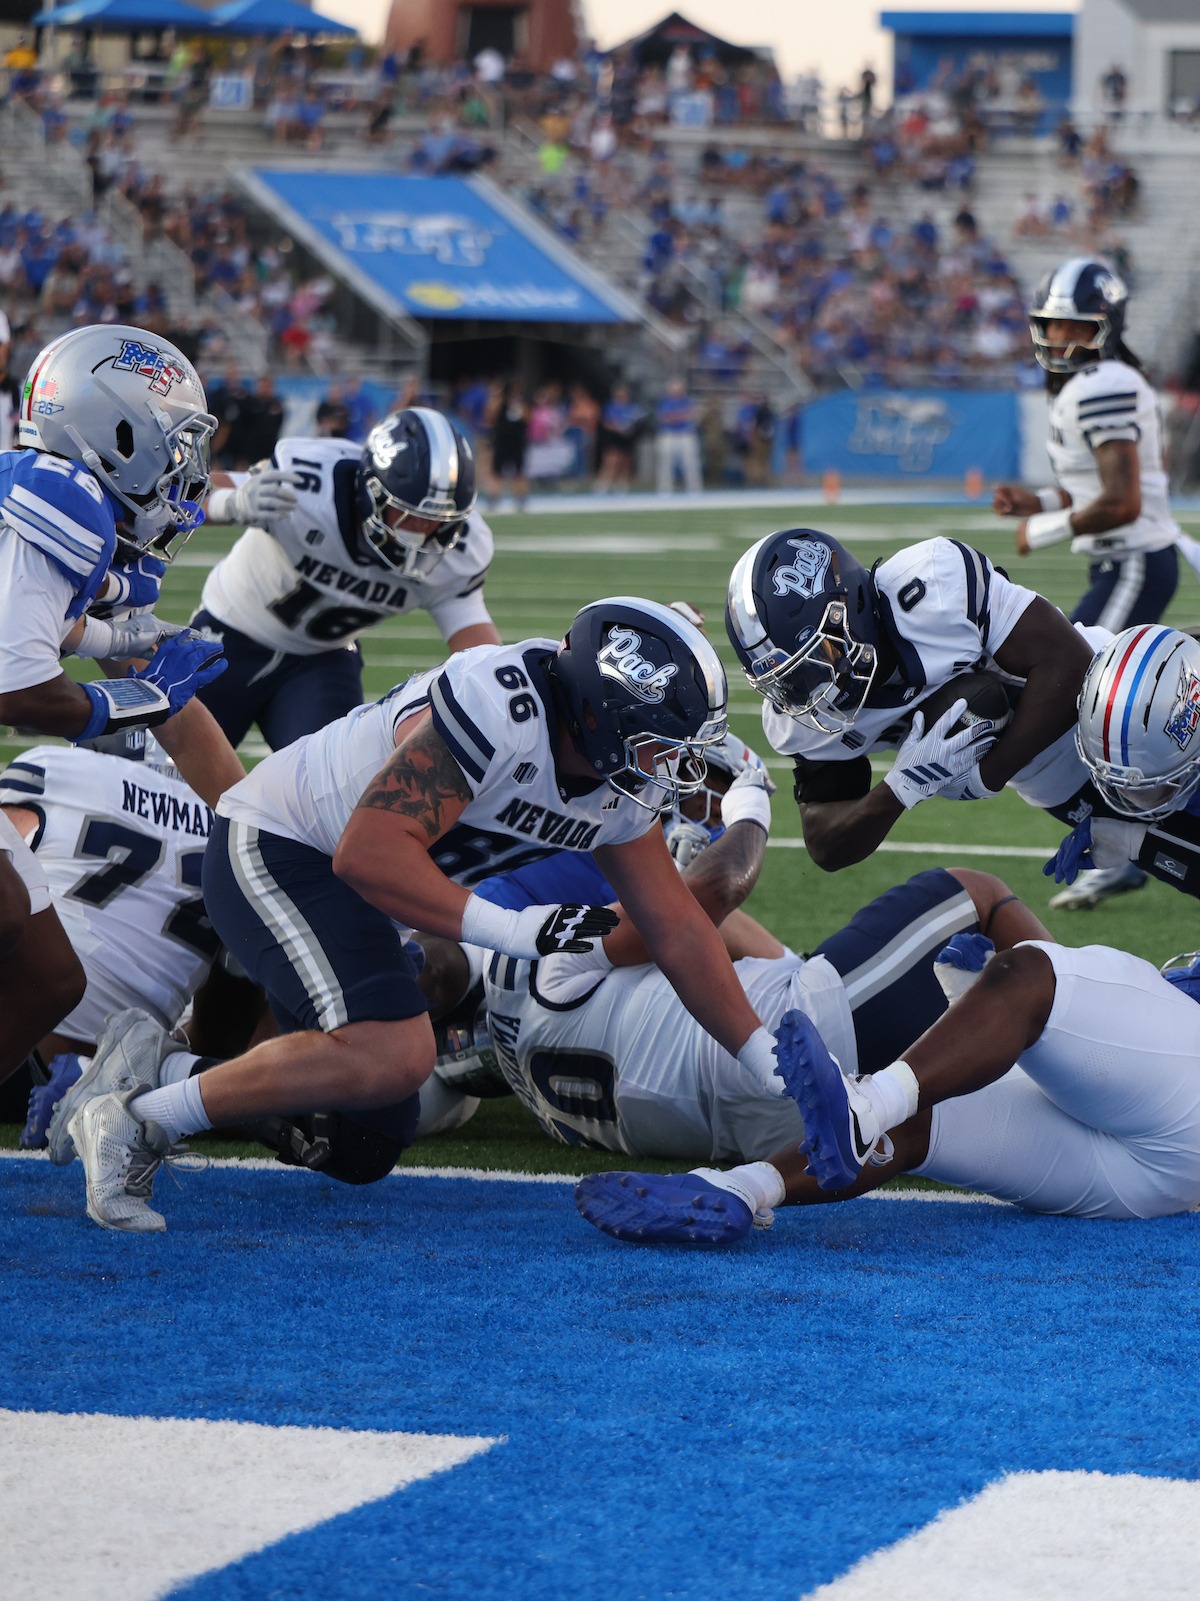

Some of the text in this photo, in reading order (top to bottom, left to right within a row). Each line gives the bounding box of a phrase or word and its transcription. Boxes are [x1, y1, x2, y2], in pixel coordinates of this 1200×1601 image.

[294, 554, 409, 609] NEVADA
[772, 538, 833, 599] Pack
[897, 576, 926, 612] 0
[596, 624, 681, 705] Pack
[495, 664, 539, 725] 66
[495, 797, 603, 850] NEVADA
